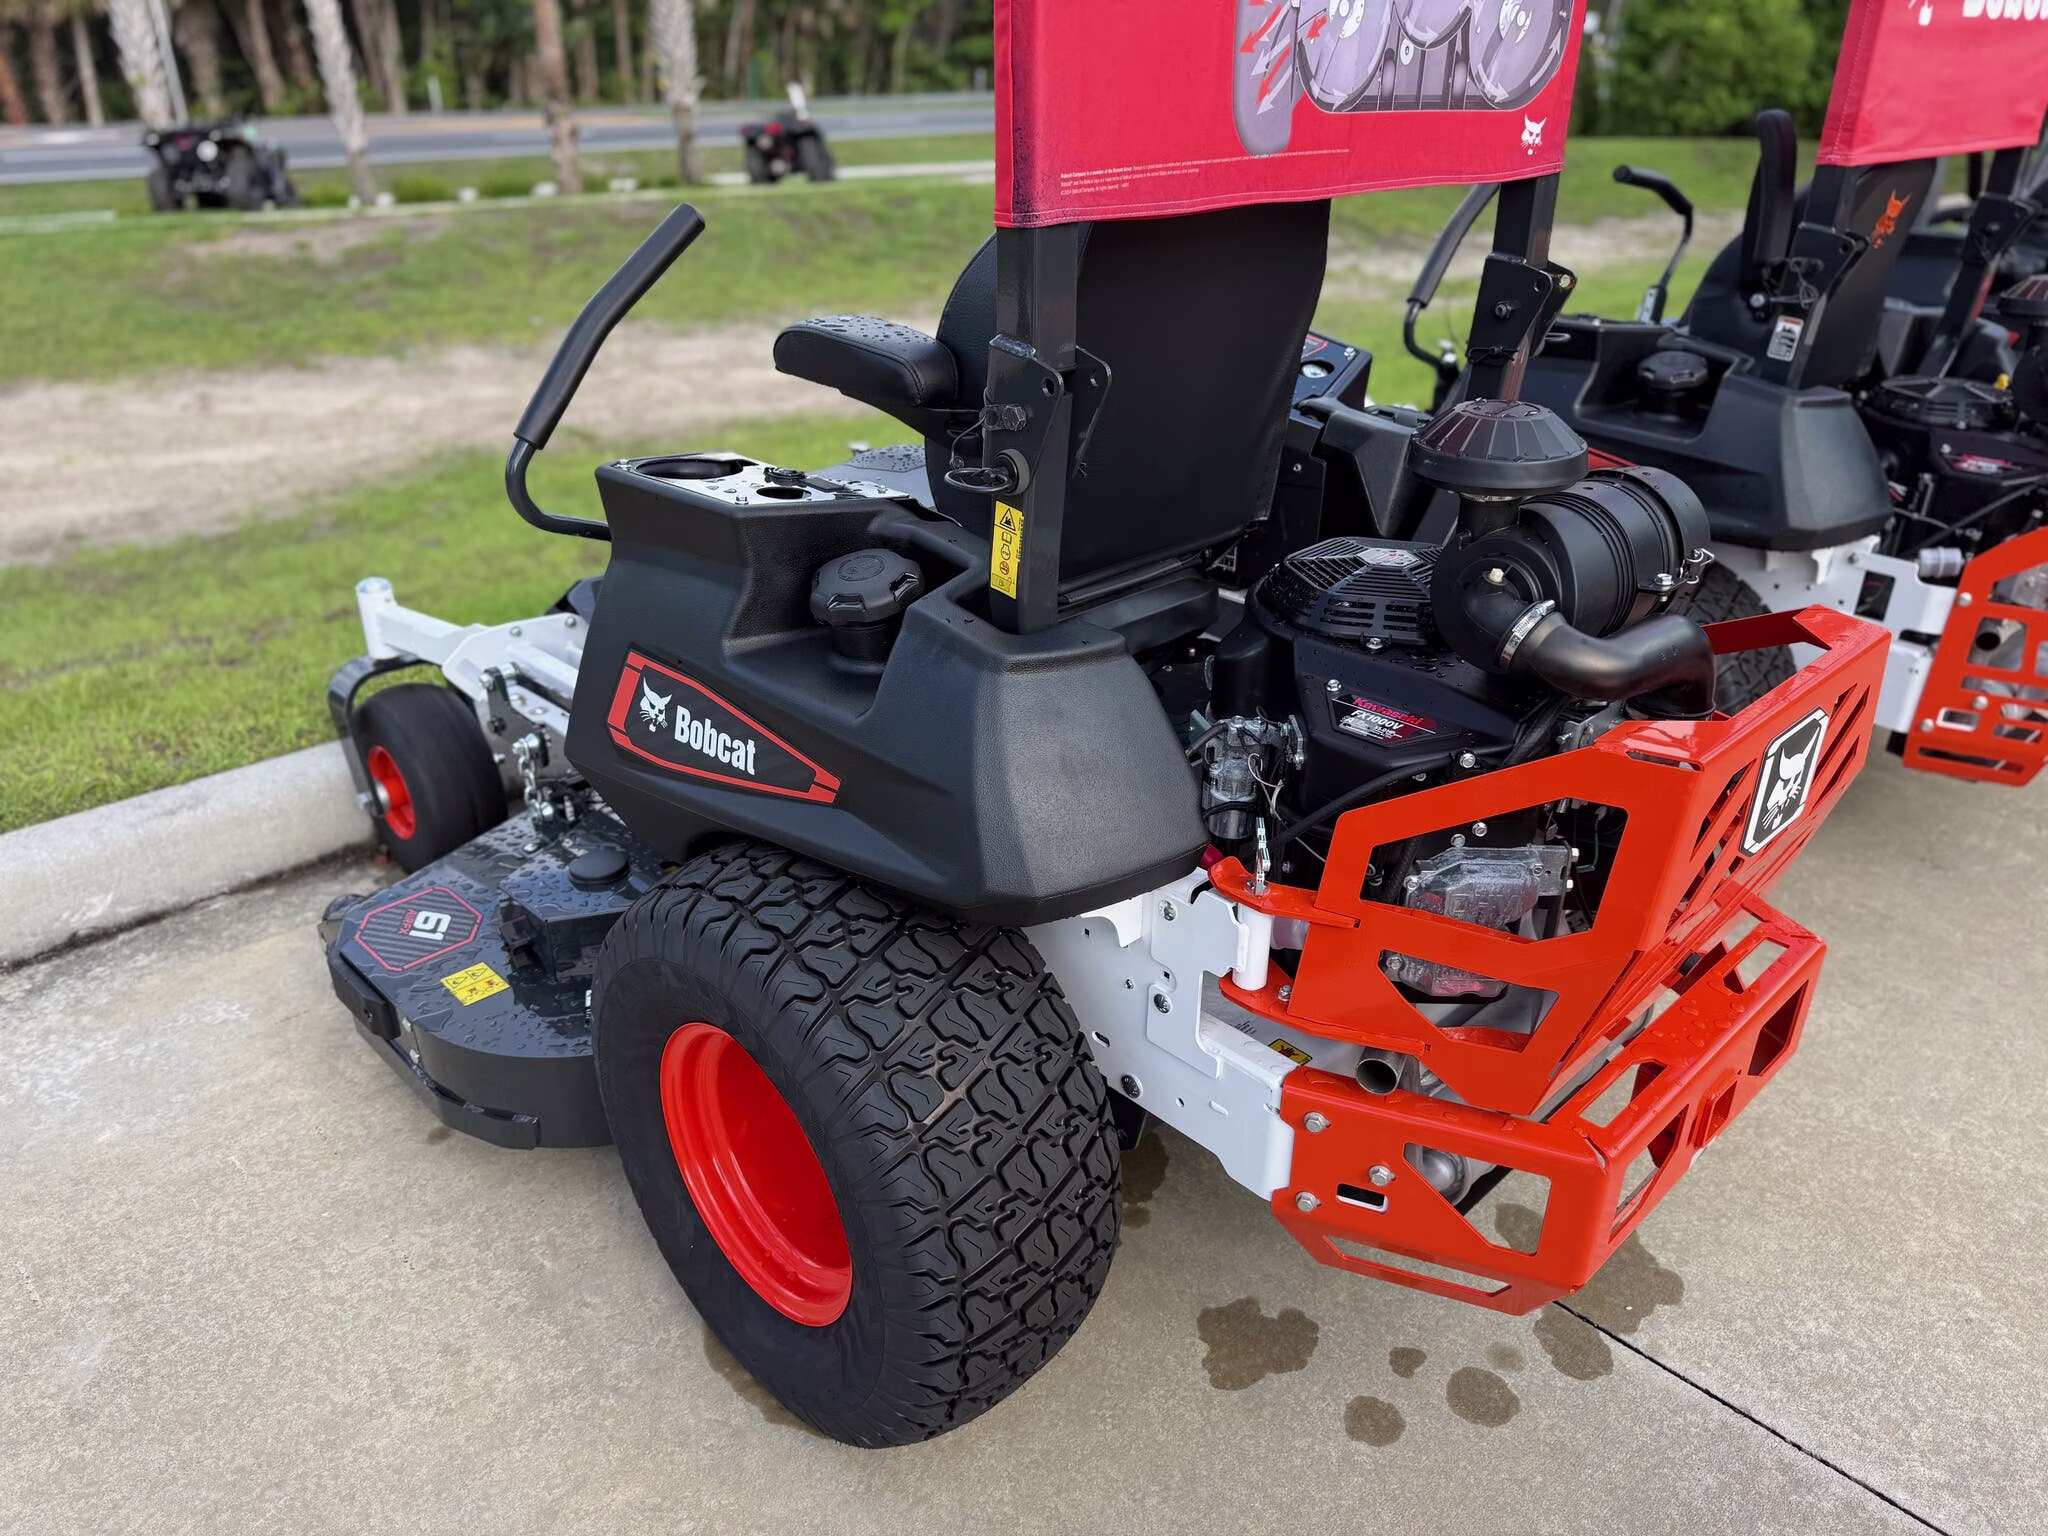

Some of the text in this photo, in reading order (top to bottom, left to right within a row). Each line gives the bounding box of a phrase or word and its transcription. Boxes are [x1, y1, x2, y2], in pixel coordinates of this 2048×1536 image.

[1351, 709, 1405, 730] FX1000V
[1353, 698, 1424, 726] Kawasaki
[674, 705, 756, 776] Bobcat
[410, 911, 452, 941] 61
